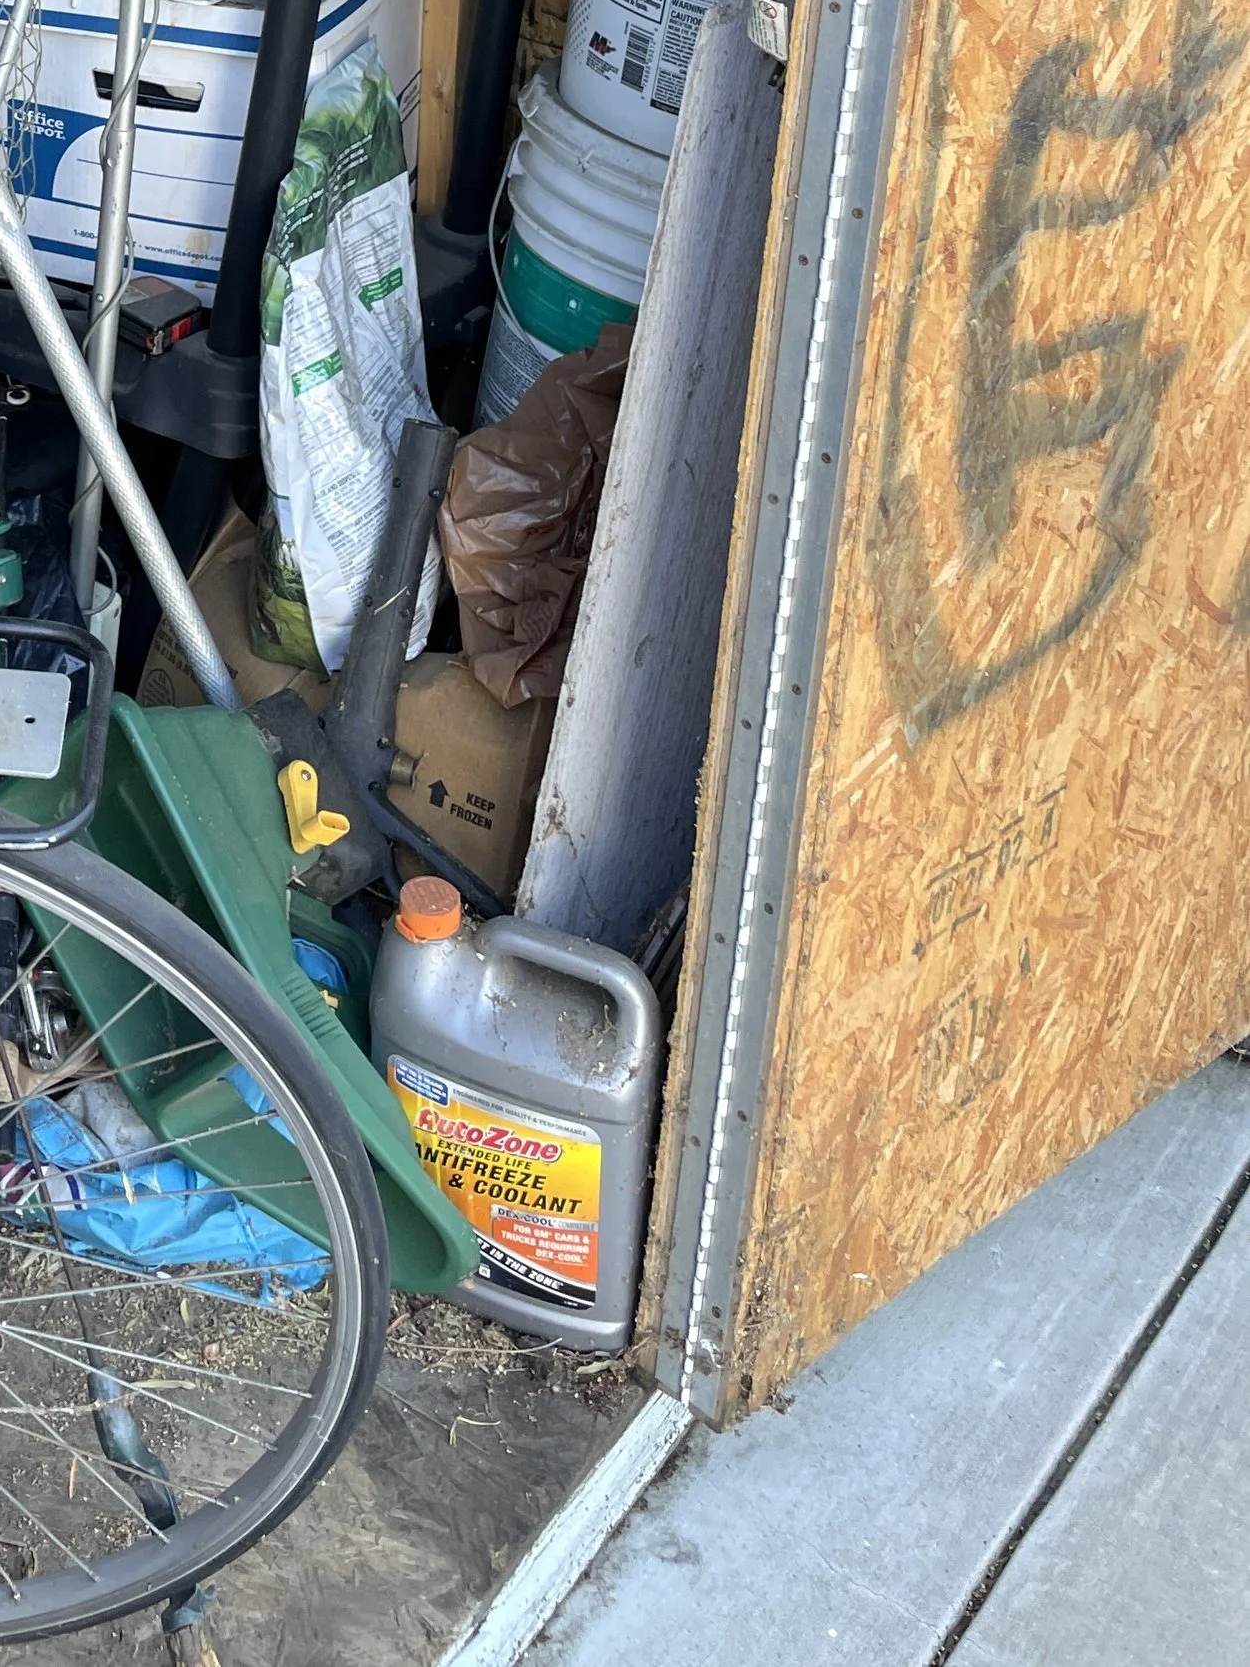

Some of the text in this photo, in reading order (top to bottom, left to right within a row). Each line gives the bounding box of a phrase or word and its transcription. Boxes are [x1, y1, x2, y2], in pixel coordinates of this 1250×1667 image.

[14, 110, 65, 129] Office
[144, 244, 222, 262] www.officedepot.co
[466, 792, 496, 813] KEEP
[450, 803, 493, 831] FROZEN
[491, 1103, 503, 1114] FOR
[505, 1108, 531, 1122] QUALITY
[538, 1119, 587, 1137] PERFORMANCE
[417, 1108, 561, 1162] AutoZone
[438, 1139, 533, 1171] EXTENDED LIFE
[449, 1174, 582, 1214] & COOLANT
[501, 1230, 589, 1254] TRUCKS REQUIRING
[513, 1224, 532, 1235] FOR
[554, 1232, 580, 1243] CARS
[490, 1247, 505, 1260] IN
[505, 1256, 528, 1274] THE
[528, 1269, 561, 1290] ZONE
